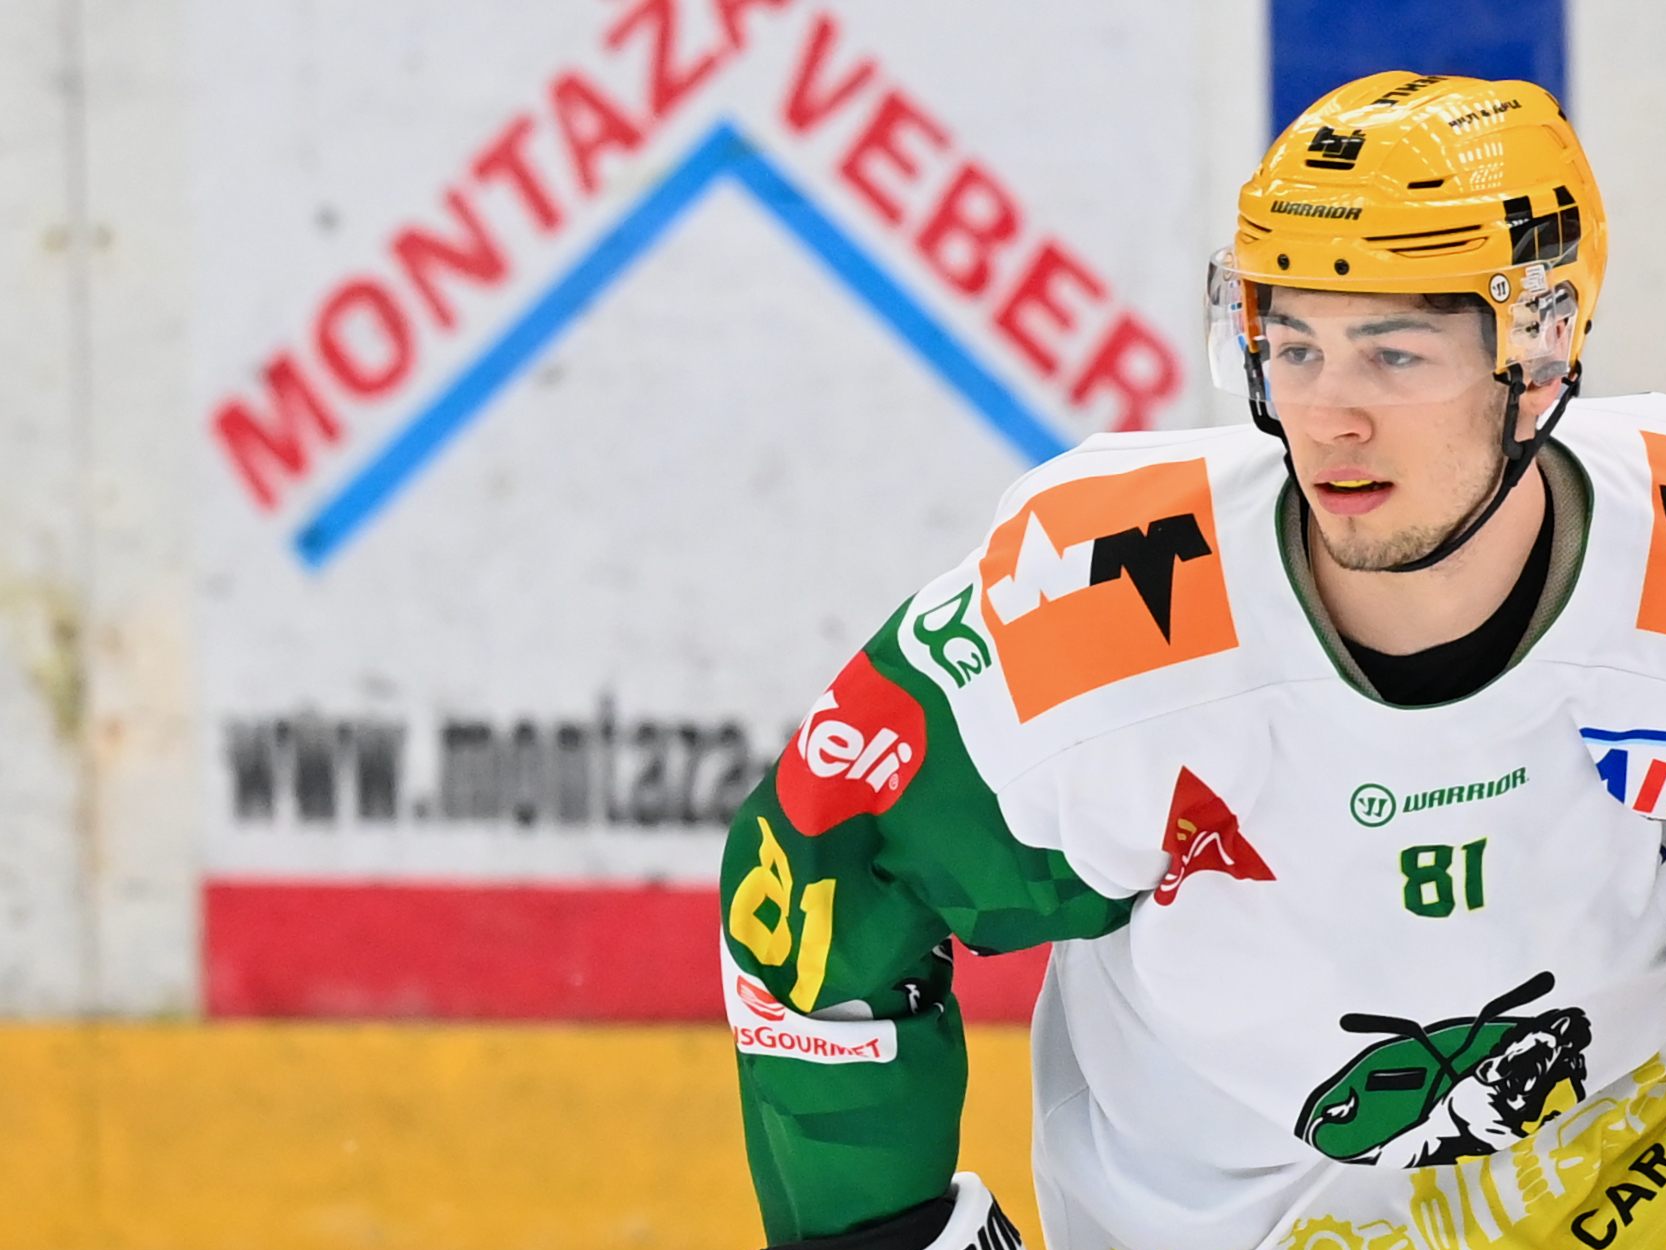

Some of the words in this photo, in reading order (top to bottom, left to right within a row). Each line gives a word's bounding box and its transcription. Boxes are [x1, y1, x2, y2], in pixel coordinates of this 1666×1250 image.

[783, 12, 1181, 431] VEBER
[1270, 200, 1362, 220] WARRIOR
[1402, 767, 1527, 813] WARRIOR
[1400, 837, 1488, 918] 81
[729, 816, 837, 1014] 81
[734, 1026, 881, 1058] SGOURMET
